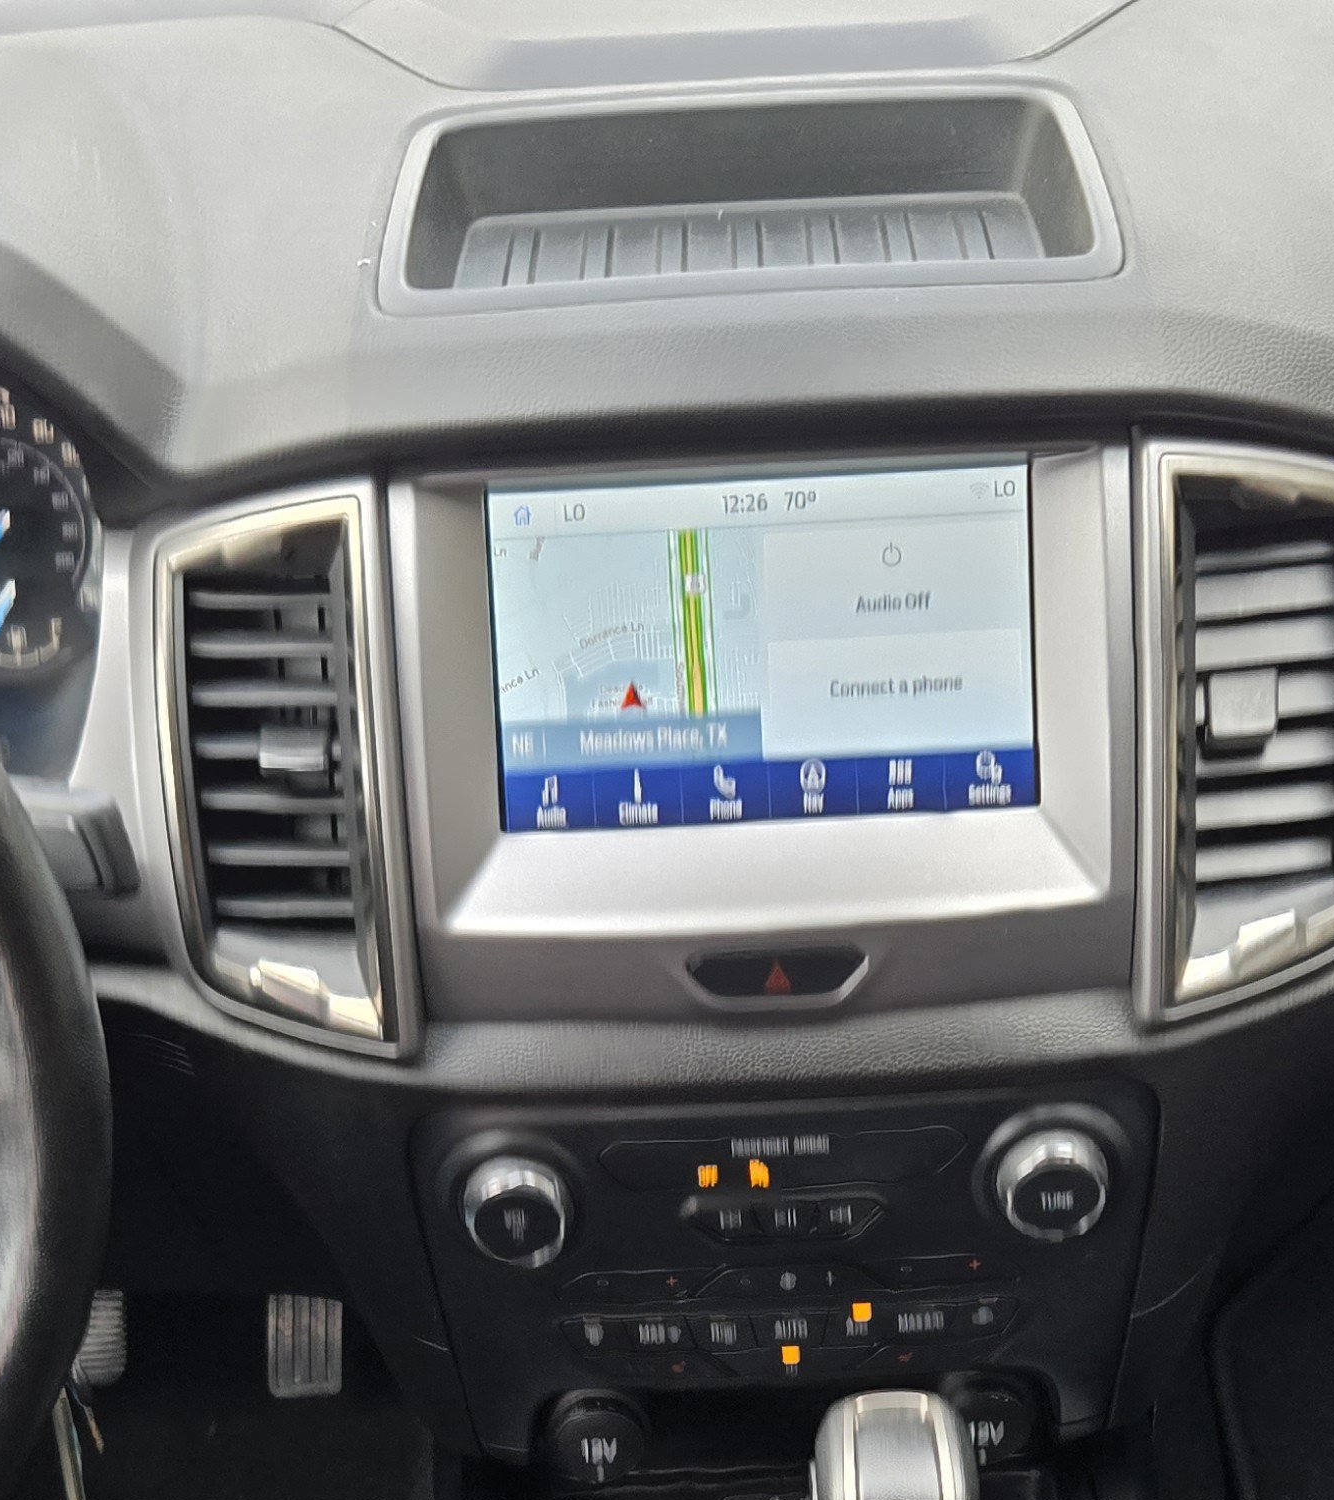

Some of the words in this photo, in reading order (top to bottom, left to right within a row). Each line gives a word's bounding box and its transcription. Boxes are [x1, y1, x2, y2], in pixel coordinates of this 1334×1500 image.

[993, 480, 1016, 499] LO
[563, 503, 586, 523] LO
[722, 493, 768, 515] 12:26
[855, 595, 901, 614] Audio
[905, 590, 931, 611] Off
[630, 621, 645, 633] Ln
[829, 678, 895, 698] Connect
[898, 680, 908, 694] a
[912, 675, 963, 698] phone
[579, 729, 655, 756] Meadows
[707, 722, 728, 749] TX
[968, 784, 1011, 807] Settings
[536, 805, 567, 829] Audio
[709, 798, 743, 821] Phone
